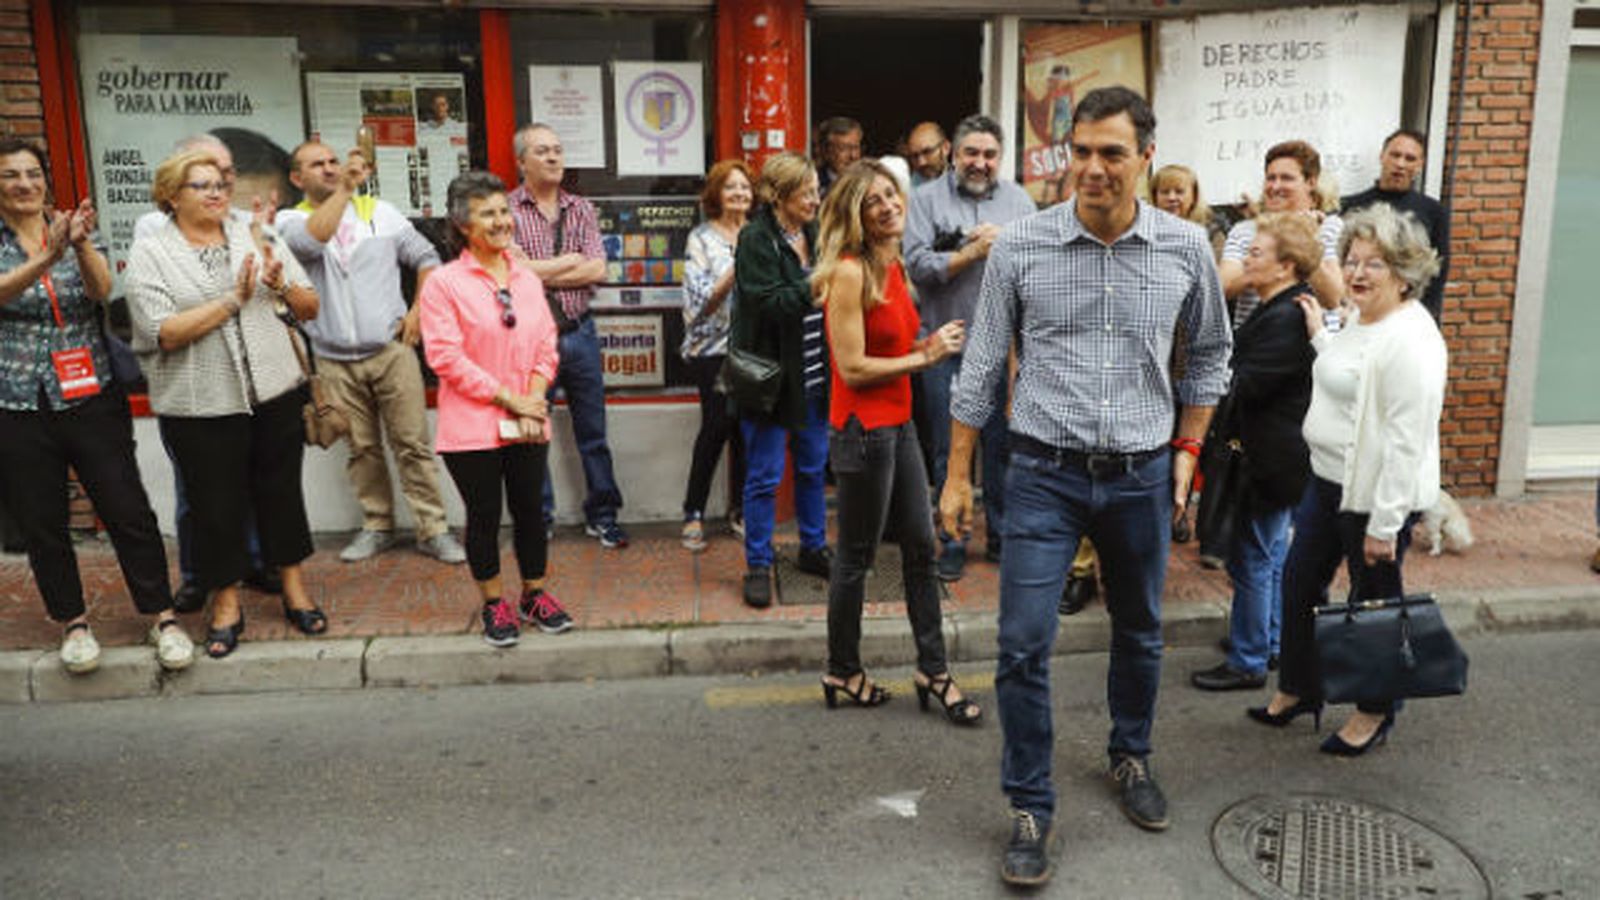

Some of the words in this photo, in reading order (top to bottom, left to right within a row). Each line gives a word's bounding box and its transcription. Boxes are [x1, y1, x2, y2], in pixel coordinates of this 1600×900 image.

[1202, 40, 1328, 68] DERECHOS
[97, 65, 229, 98] gobernar
[1223, 69, 1300, 91] PADRE
[115, 94, 156, 113] PARA
[160, 94, 180, 113] LA
[599, 334, 656, 348] aborto
